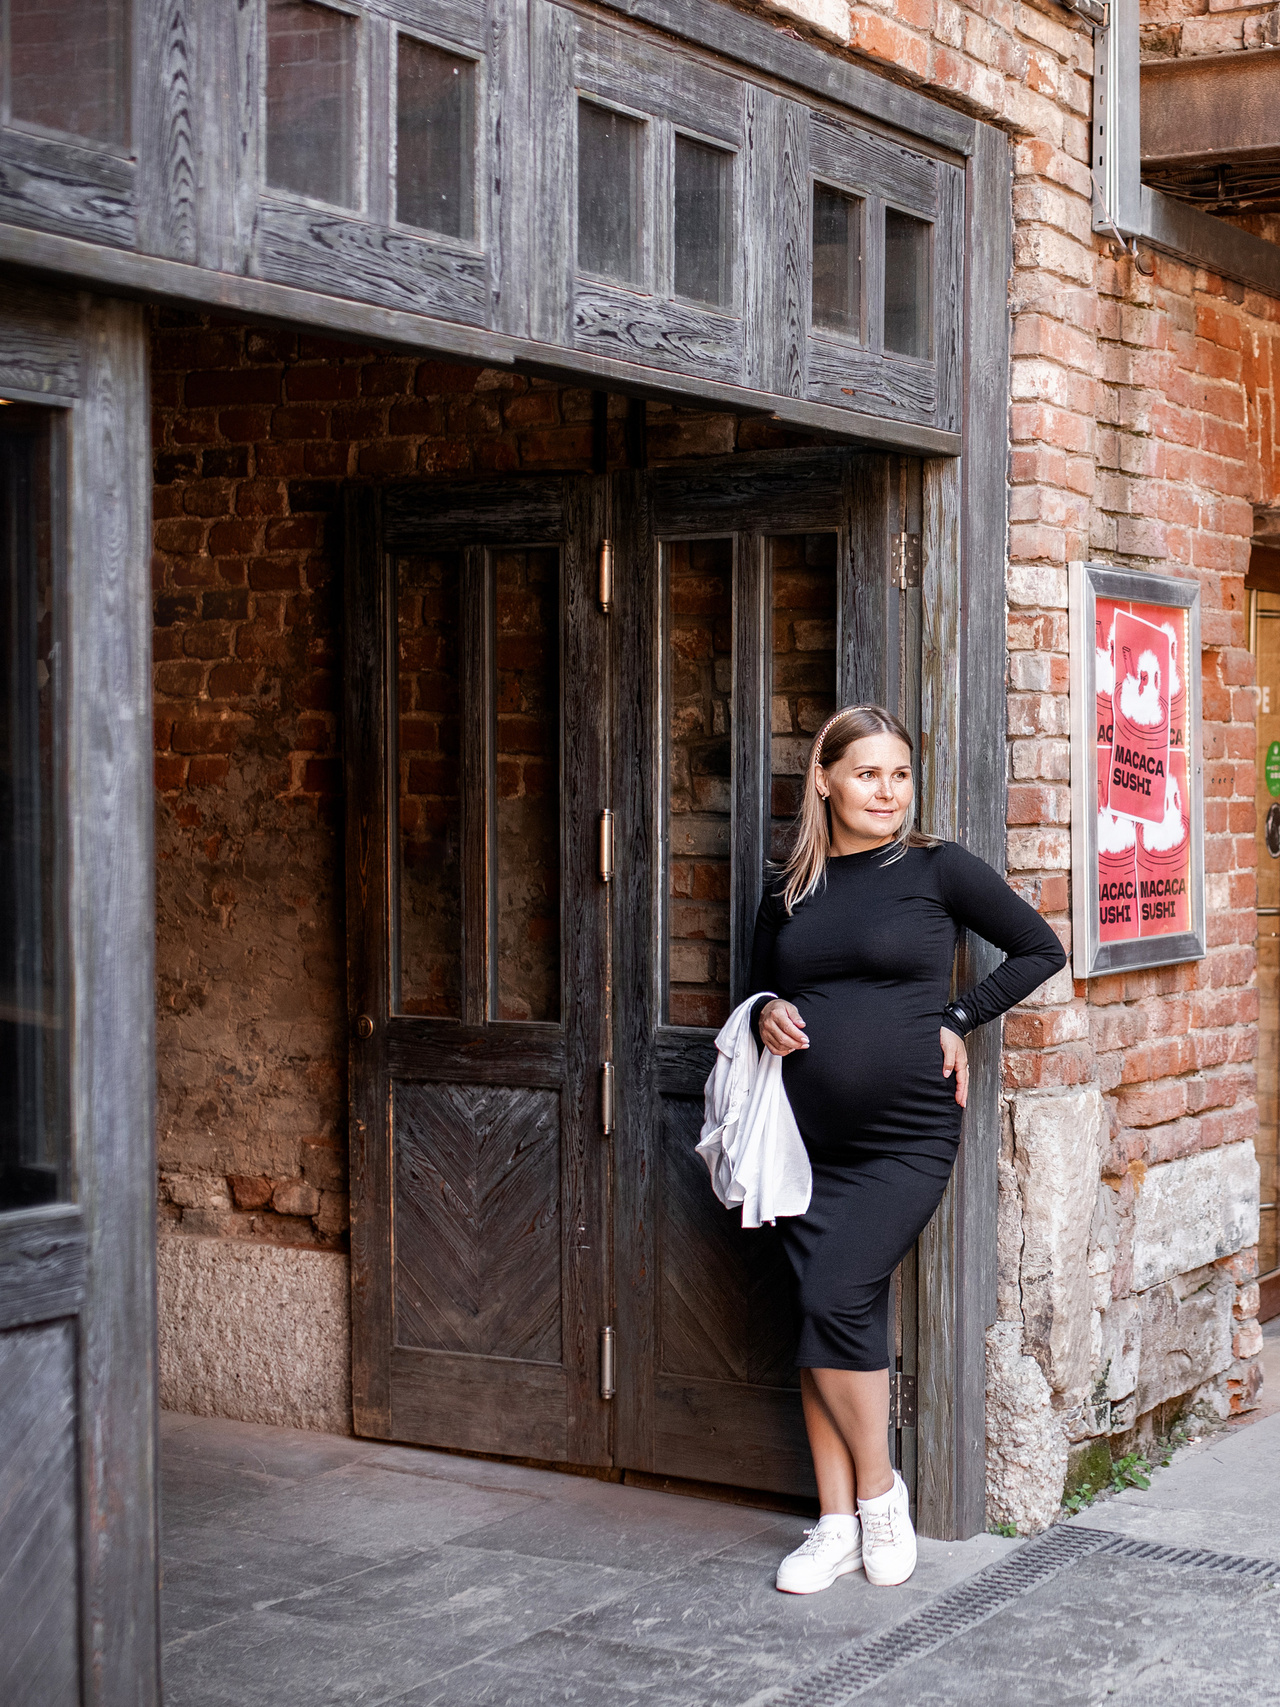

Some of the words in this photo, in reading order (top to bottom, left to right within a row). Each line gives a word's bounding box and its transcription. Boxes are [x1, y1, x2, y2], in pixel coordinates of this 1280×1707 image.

[1114, 744, 1165, 778] MACACA
[1112, 767, 1152, 797] SUSHI
[1099, 881, 1138, 902] ACAC
[1140, 878, 1186, 899] MACACA
[1099, 904, 1132, 925] USHI
[1141, 900, 1176, 921] SUSHI
